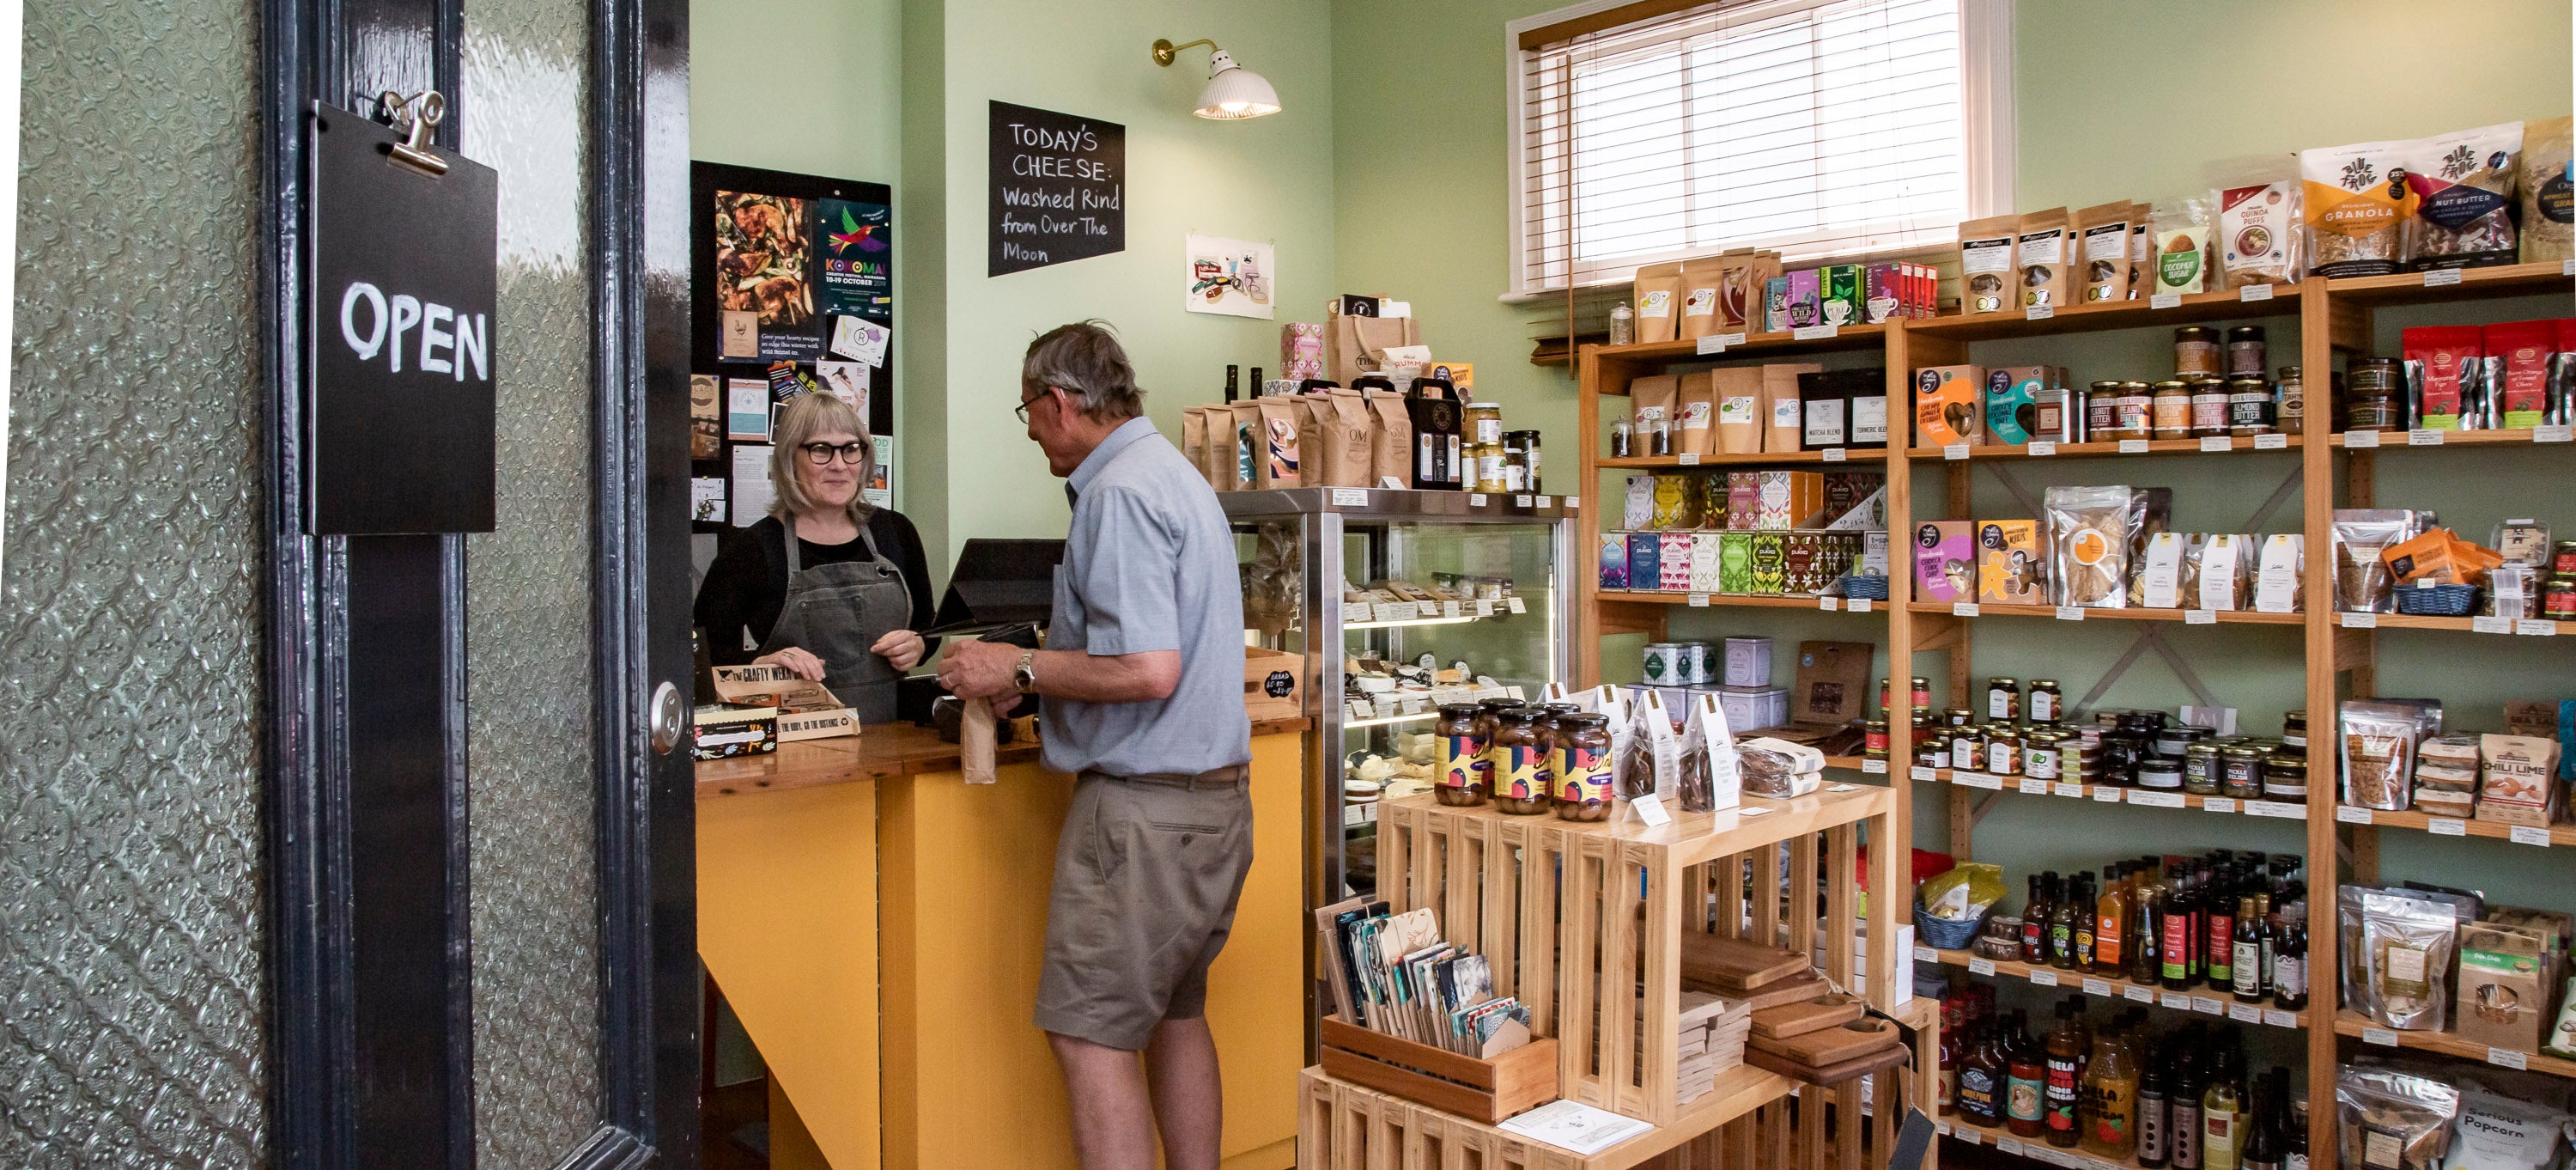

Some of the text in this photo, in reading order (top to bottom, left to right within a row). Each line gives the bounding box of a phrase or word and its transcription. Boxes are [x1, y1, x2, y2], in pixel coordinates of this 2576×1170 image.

[1009, 124, 1098, 152] TODAY'S
[2444, 144, 2476, 163] BLUE
[1012, 154, 1112, 181] CHEESE:
[2342, 157, 2373, 174] BLUE
[2439, 158, 2478, 180] FROG
[2340, 171, 2377, 192] FROG
[1003, 185, 1120, 210] Washed Rind
[2457, 195, 2491, 205] BUTTER
[2240, 209, 2269, 218] QUINOA
[2243, 216, 2264, 225] PUFFS
[2325, 207, 2394, 222] GRANOLA
[1001, 212, 1108, 235] from Over The
[1004, 242, 1048, 262] Moon
[825, 259, 886, 275] KOKOMAI
[2164, 261, 2195, 272] COCONUT
[2167, 270, 2189, 278] SUGAR
[843, 277, 872, 286] OCTOBER
[341, 282, 488, 381] OPEN
[2120, 405, 2144, 414] PEANUT
[2234, 411, 2260, 420] BUTTER
[1349, 429, 1368, 442] OM
[1389, 427, 1406, 439] OM
[2009, 533, 2026, 544] KIDS
[743, 667, 769, 683] CRAFTY
[781, 723, 790, 733] THE
[790, 722, 803, 732] BODY,
[811, 720, 819, 729] THE
[819, 718, 839, 728] DISTANCE
[2483, 762, 2545, 776] CHILI LIME
[2077, 945, 2089, 954] ZEST
[2048, 1058, 2075, 1072] MELA
[2046, 1090, 2075, 1100] VINEGAR
[2468, 1107, 2523, 1126] Serious
[2464, 1115, 2525, 1138] Popcorn
